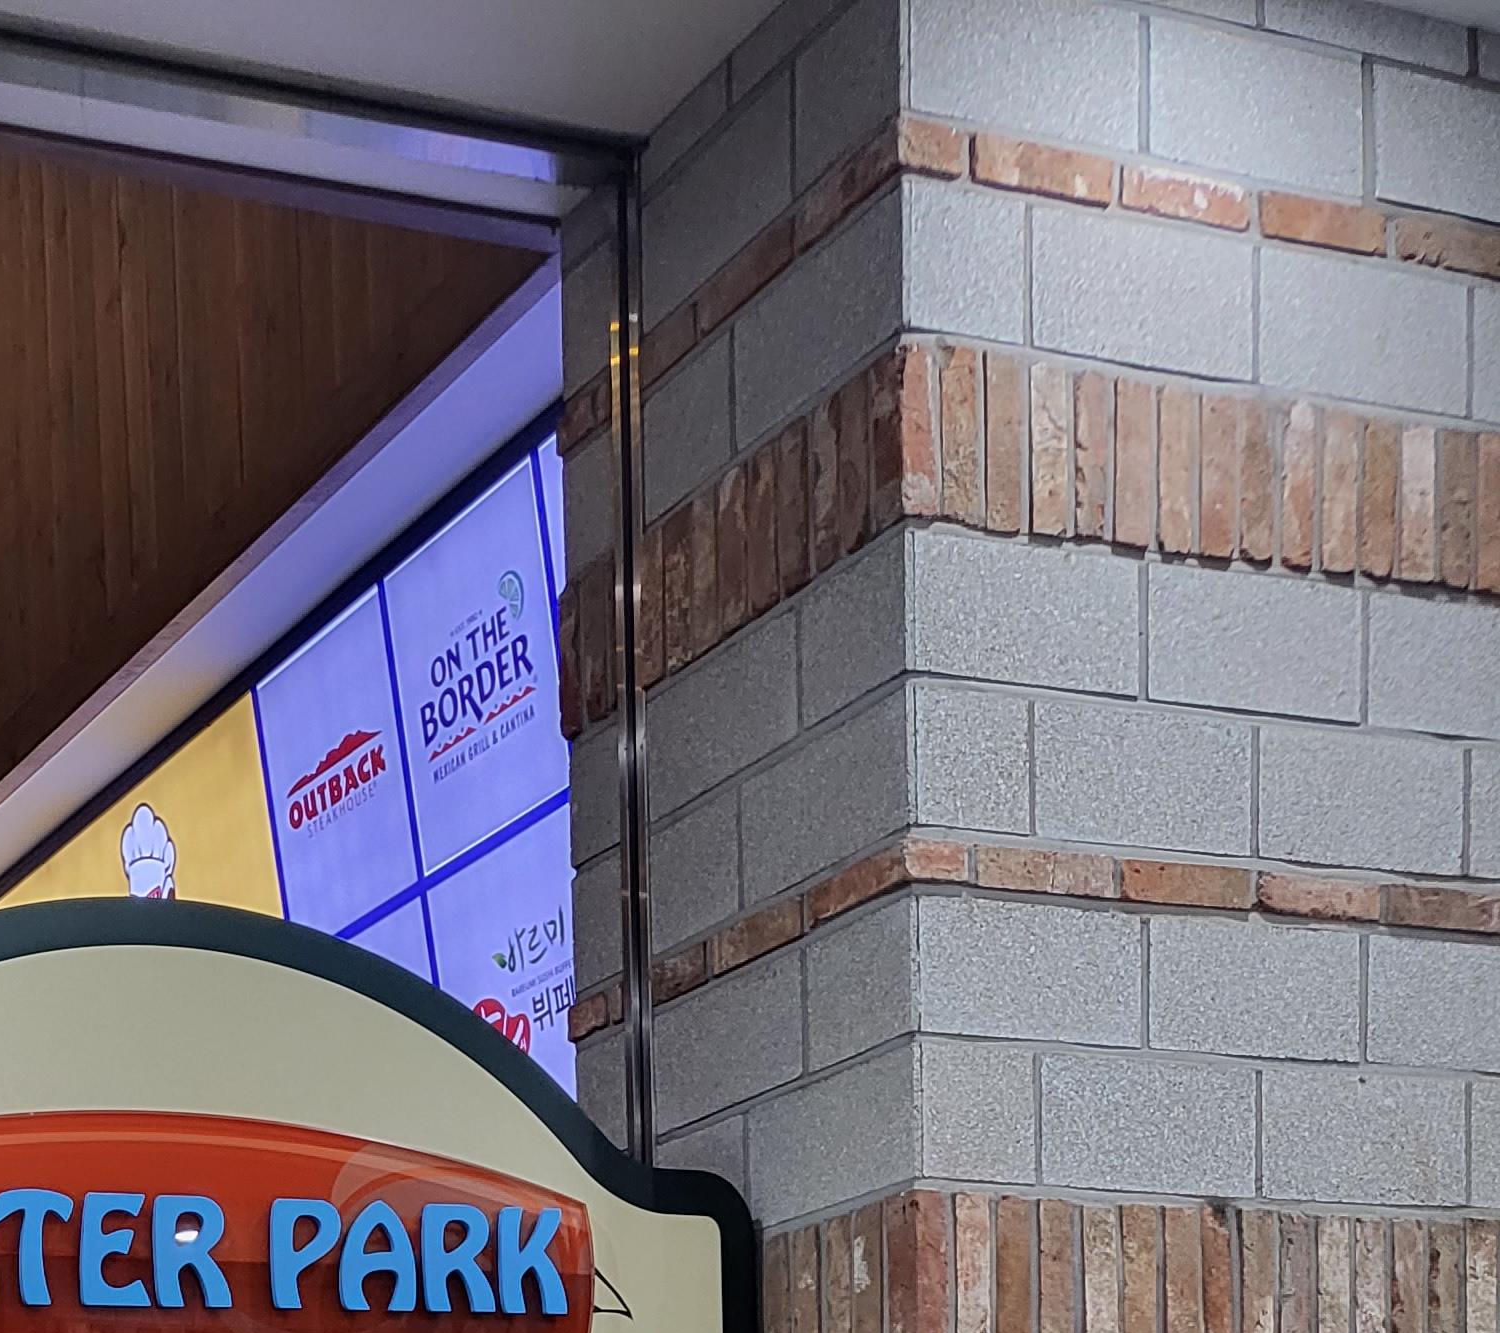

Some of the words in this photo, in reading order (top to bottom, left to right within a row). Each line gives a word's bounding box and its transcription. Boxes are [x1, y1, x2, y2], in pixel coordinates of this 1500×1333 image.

[430, 642, 462, 687] ON
[466, 606, 510, 661] THE
[420, 635, 534, 748] BORDER
[434, 752, 467, 784] MEXICAN
[468, 737, 490, 761] GRILL
[500, 705, 535, 739] CANTINA
[289, 744, 386, 829] OUTBACK
[306, 785, 376, 838] STEAKHOUSE
[270, 1196, 569, 1317] PARK
